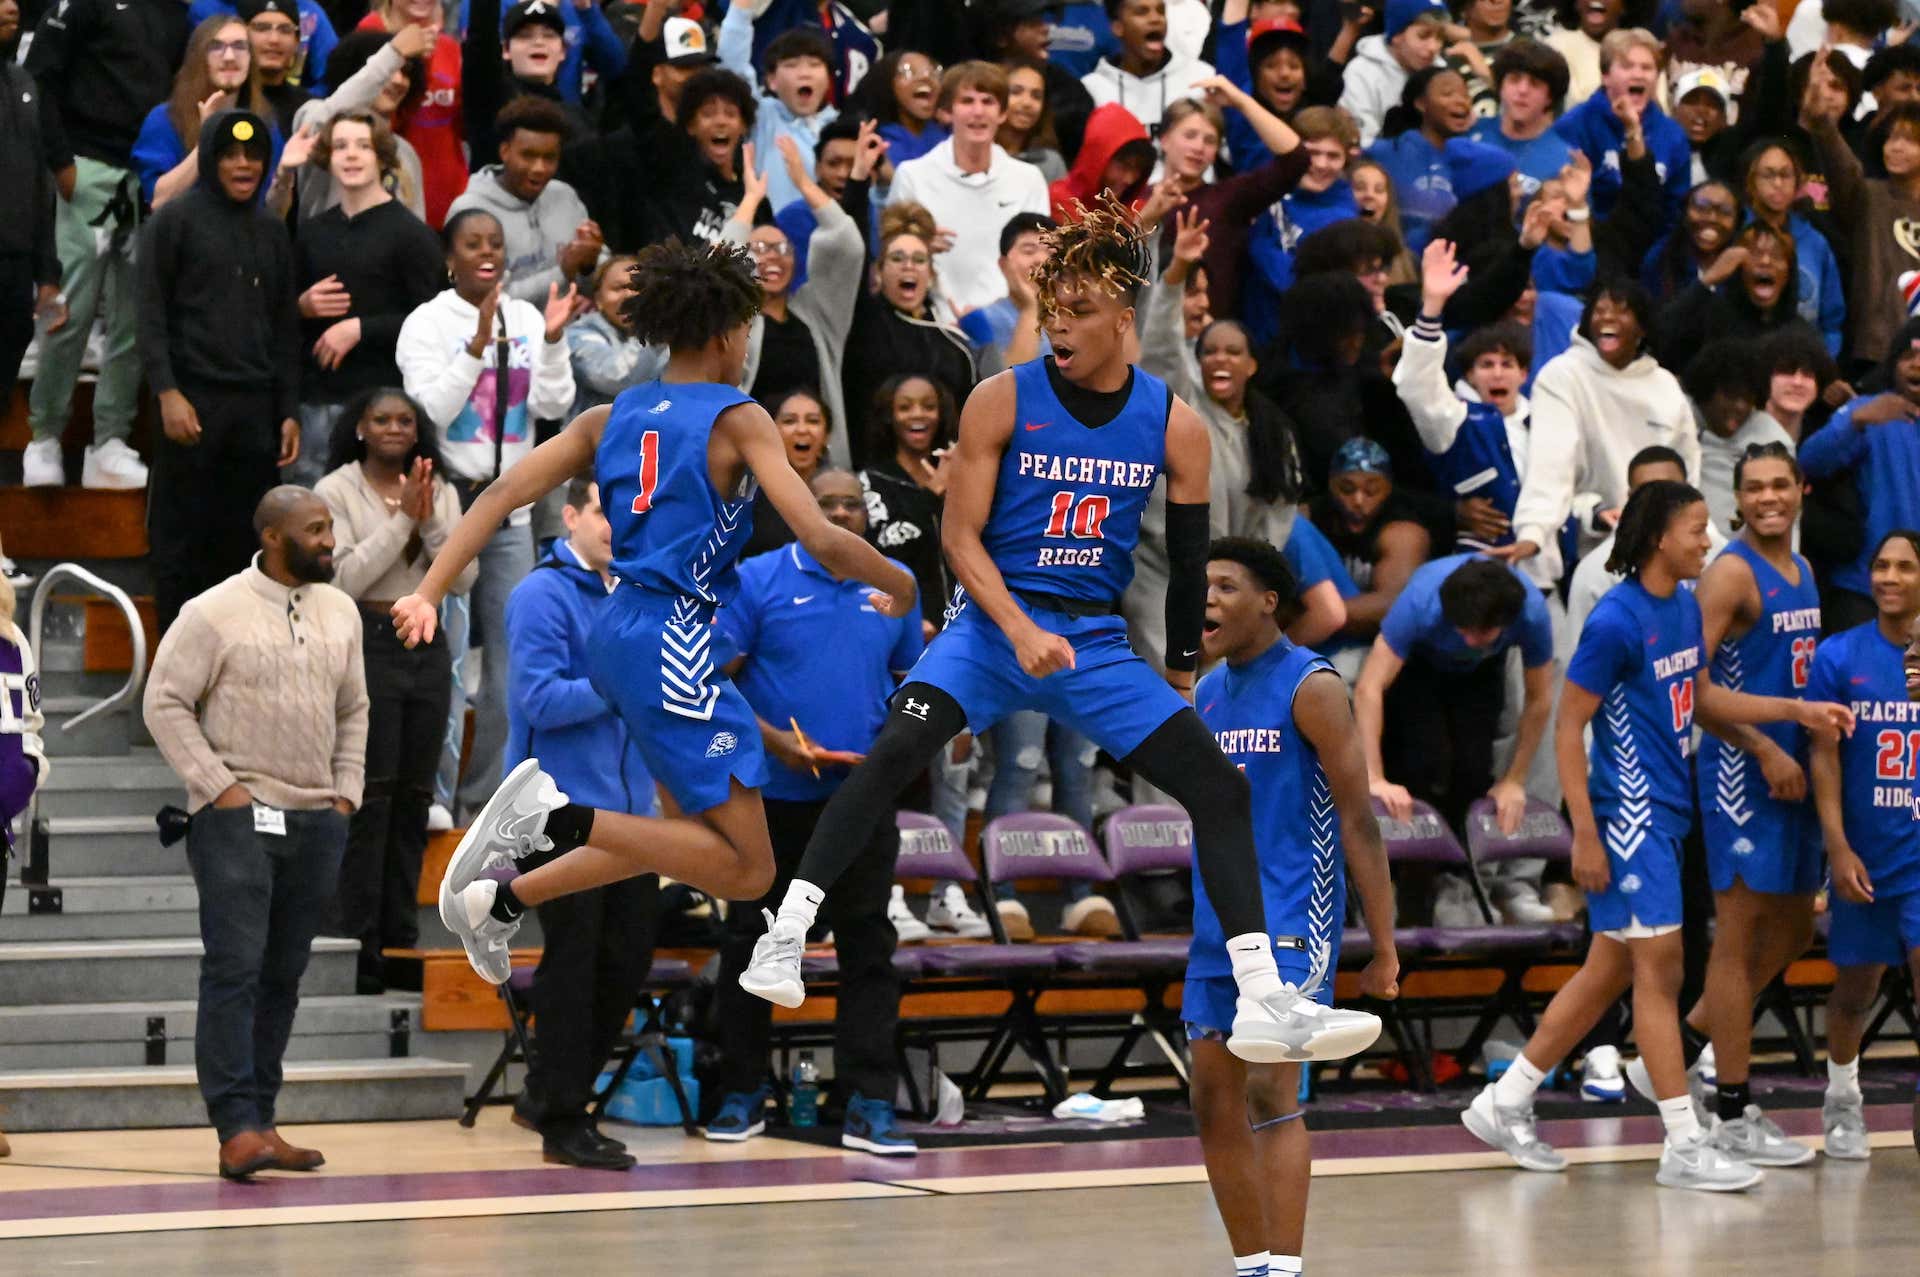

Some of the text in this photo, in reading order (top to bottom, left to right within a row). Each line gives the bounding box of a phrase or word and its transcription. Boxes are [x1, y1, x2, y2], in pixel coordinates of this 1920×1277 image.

[631, 430, 659, 515] 1
[1018, 451, 1155, 488] PEACHTREE
[1043, 490, 1110, 540] 10
[1037, 547, 1104, 567] RIDGE
